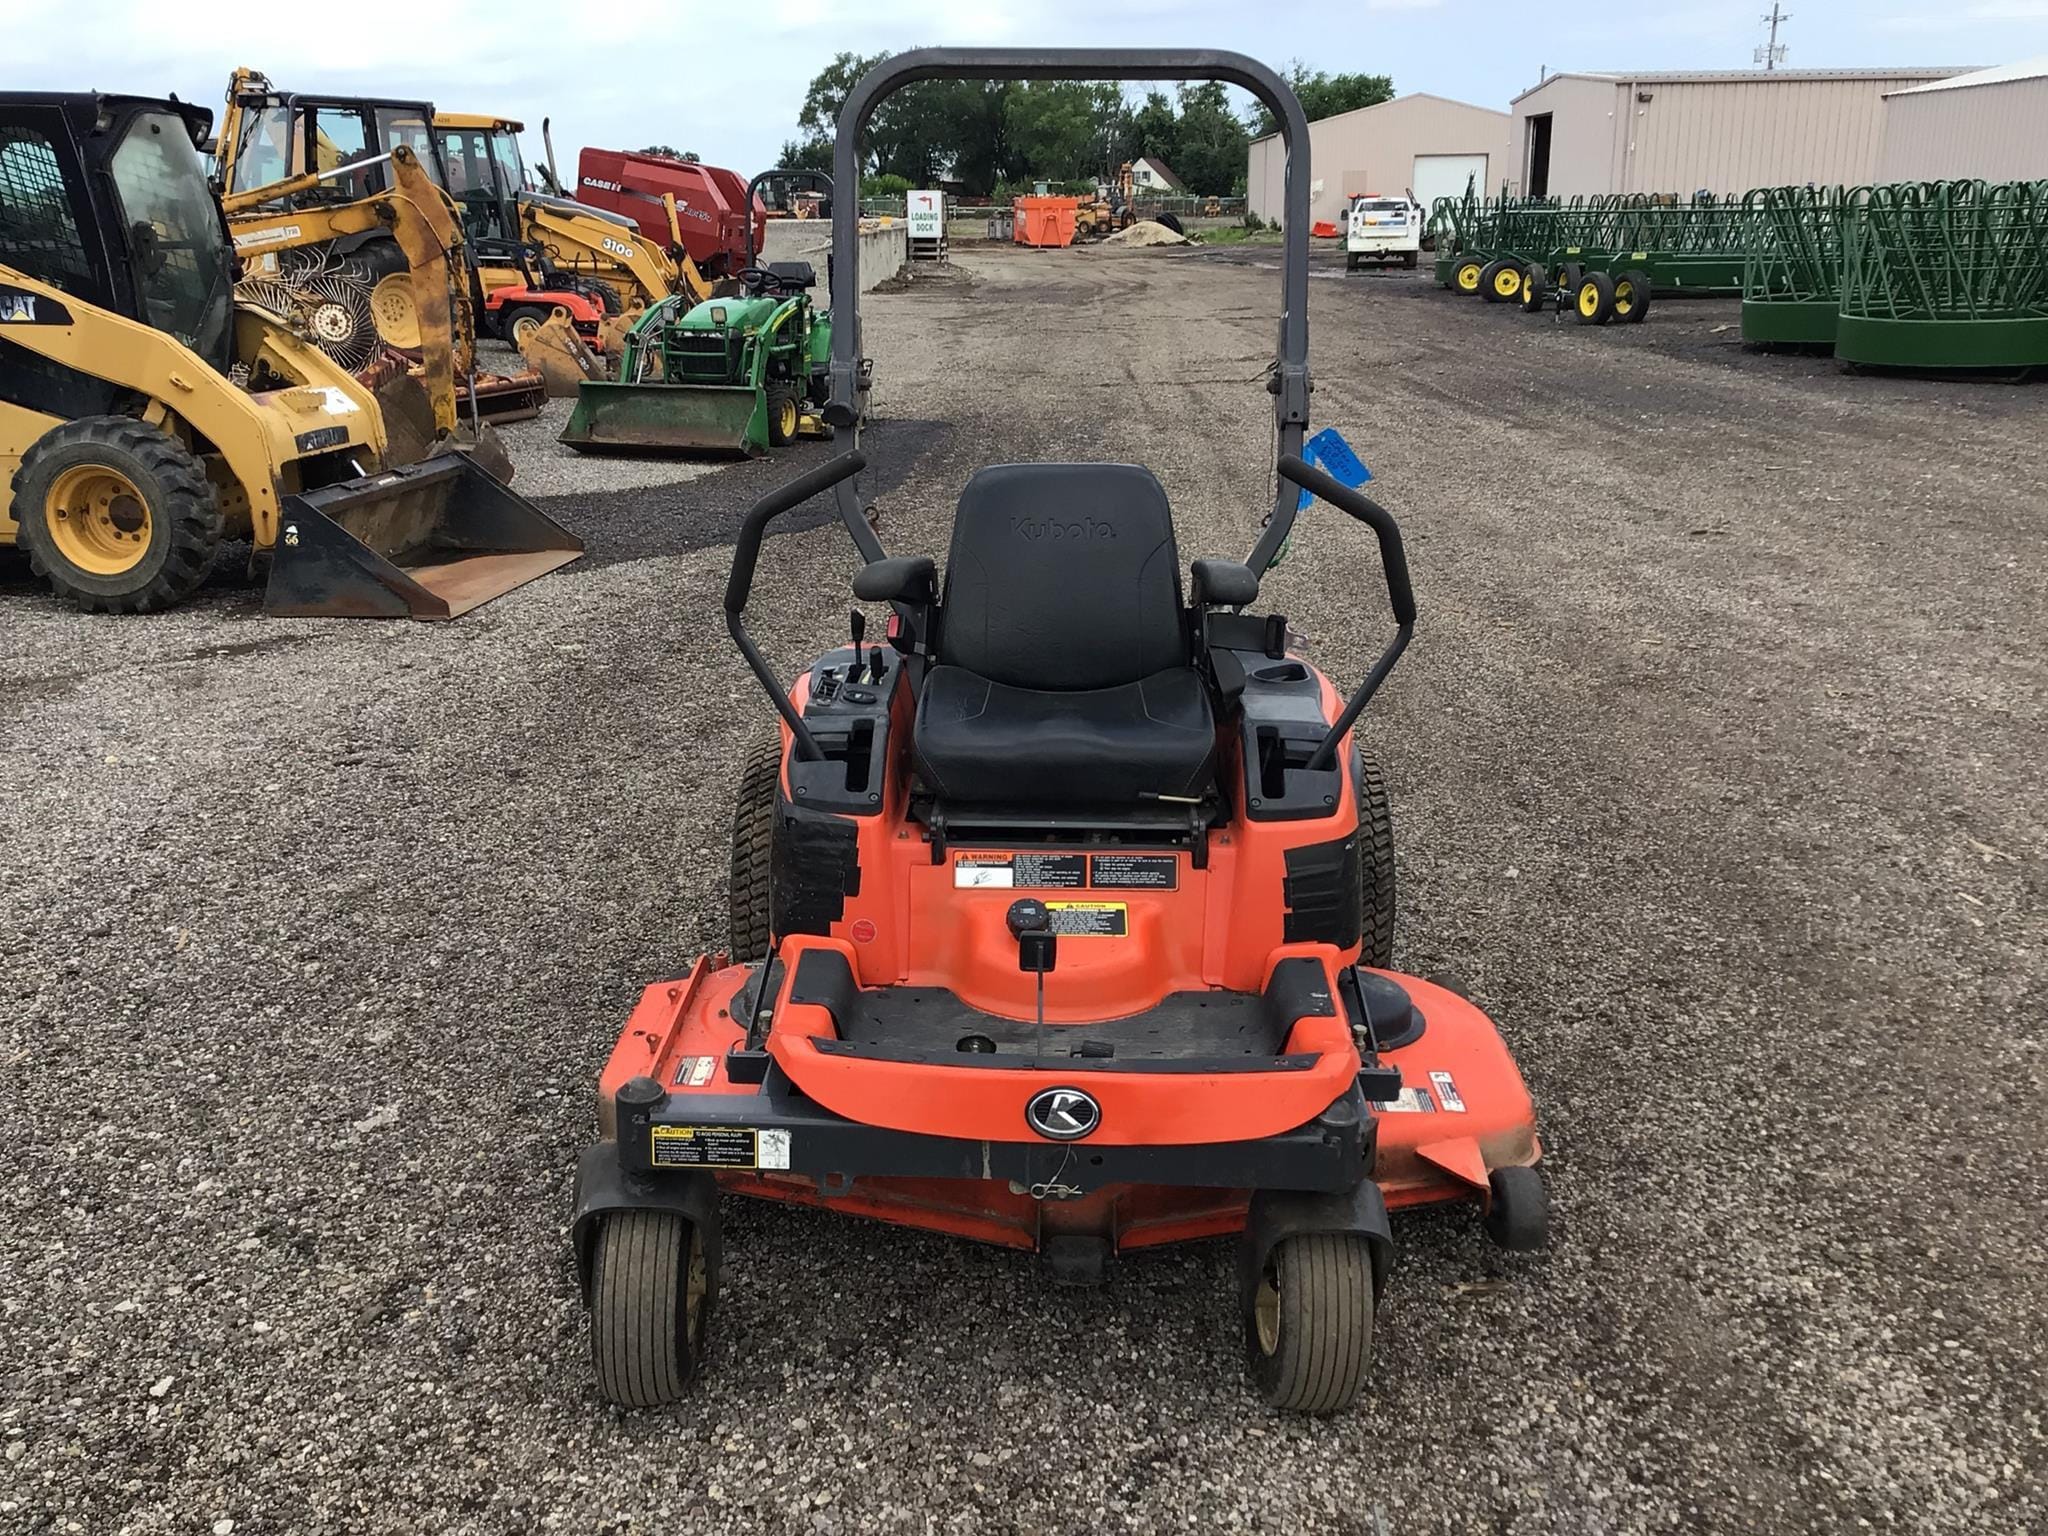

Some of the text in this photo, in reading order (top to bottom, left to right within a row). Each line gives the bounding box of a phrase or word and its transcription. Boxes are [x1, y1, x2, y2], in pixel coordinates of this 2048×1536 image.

[583, 176, 611, 190] CASE
[911, 212, 939, 221] LOADING
[916, 223, 934, 232] DOCK
[602, 238, 634, 258] 310G
[0, 295, 36, 321] CAT
[1010, 516, 1114, 541] Kubota
